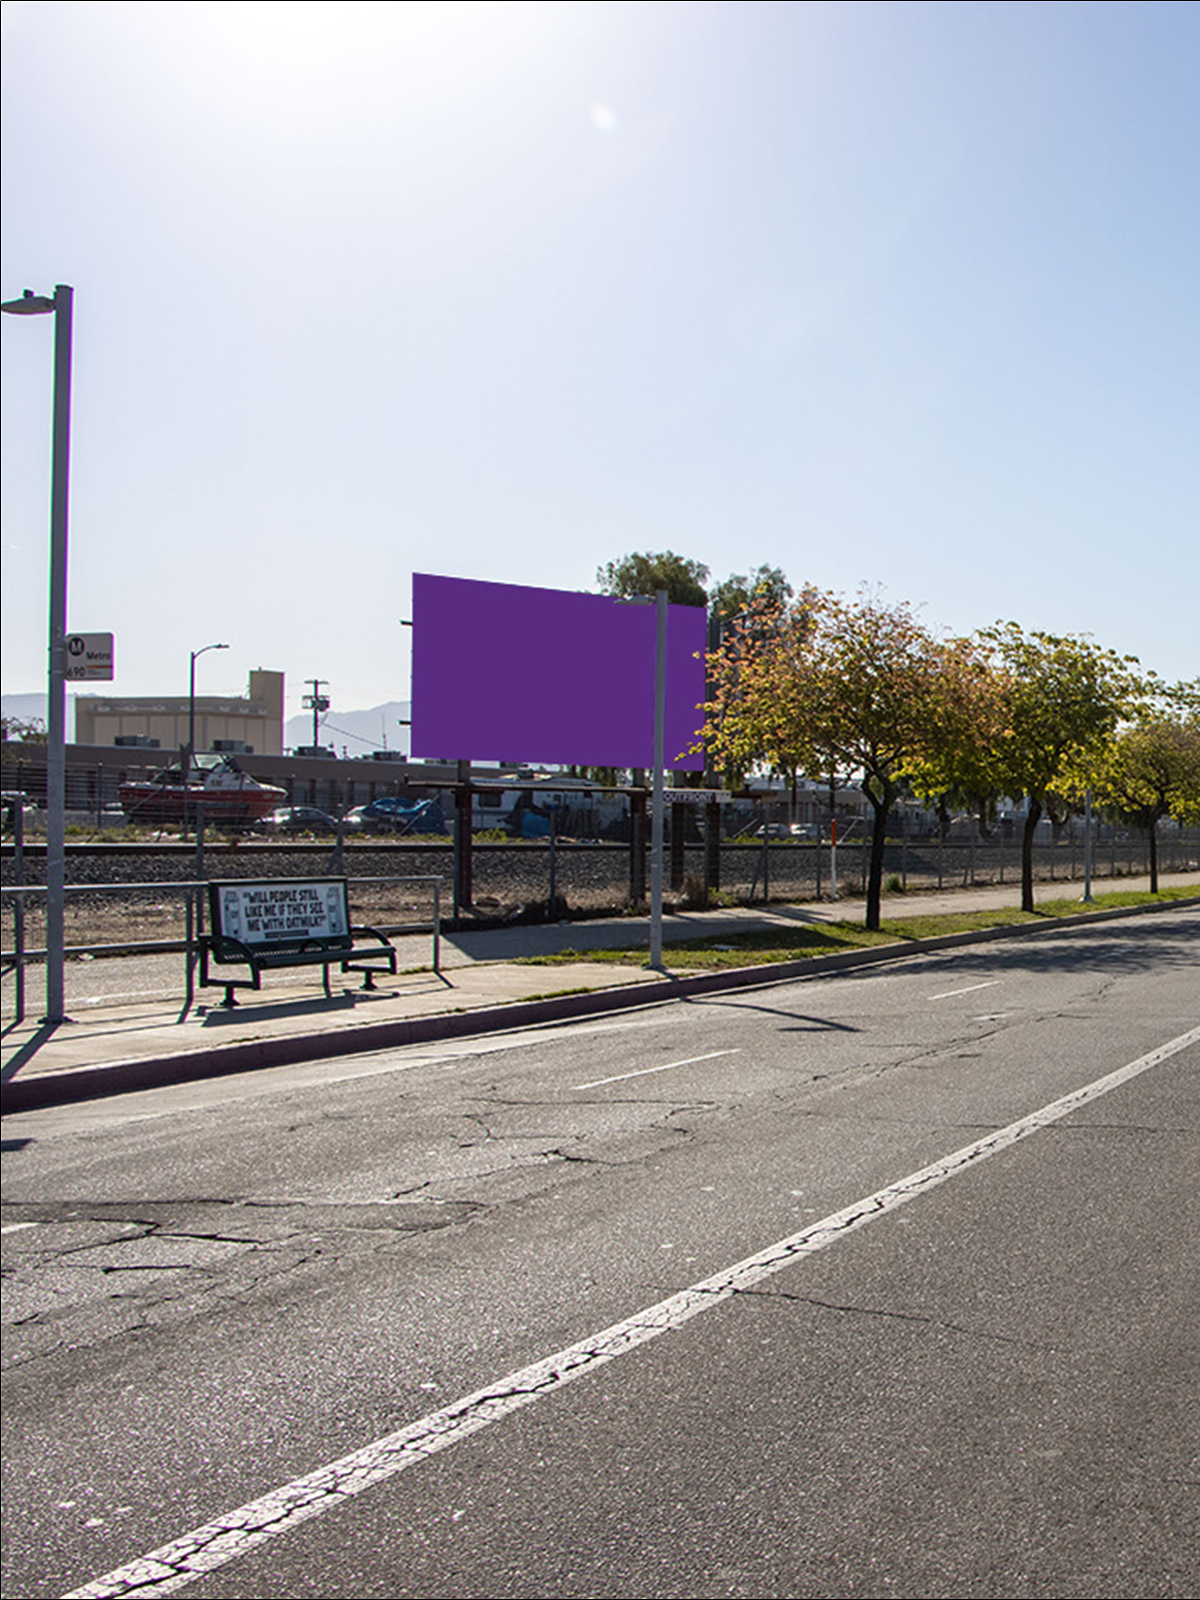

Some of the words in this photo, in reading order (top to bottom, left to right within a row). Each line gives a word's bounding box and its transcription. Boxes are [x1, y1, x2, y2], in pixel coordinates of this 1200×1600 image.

[87, 651, 111, 660] Metro
[663, 791, 714, 803] OUTFRONT
[270, 890, 298, 903] PEOPLE
[299, 889, 319, 901] STILL
[245, 905, 262, 918] LIKE
[264, 904, 276, 916] ME
[278, 904, 286, 915] IF
[287, 902, 309, 915] THEY
[310, 902, 324, 914] SEE
[248, 918, 261, 931] ME
[262, 917, 285, 930] WITH
